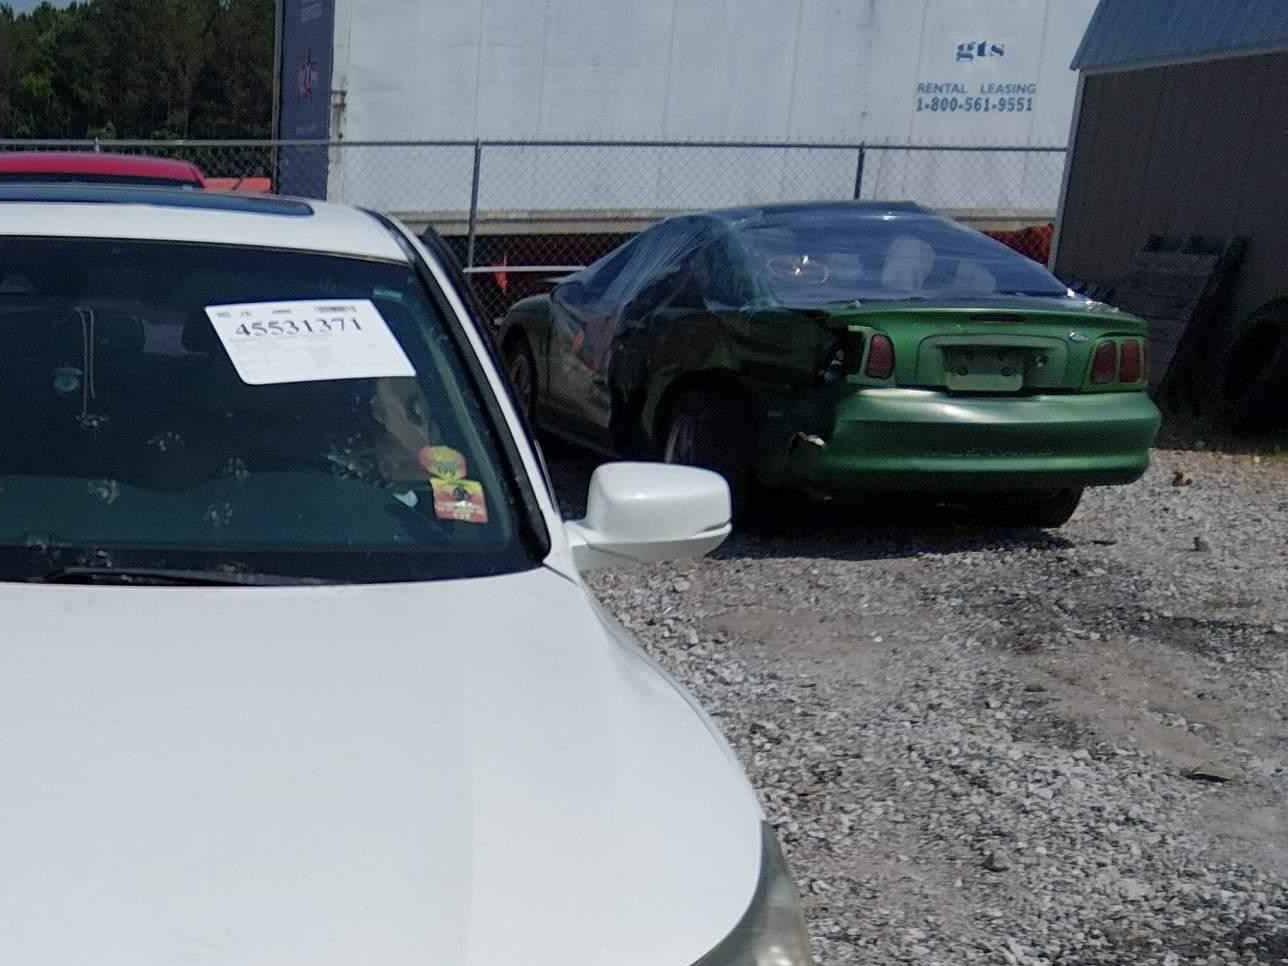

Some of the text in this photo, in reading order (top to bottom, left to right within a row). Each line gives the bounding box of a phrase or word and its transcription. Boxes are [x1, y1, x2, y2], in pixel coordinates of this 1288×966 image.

[956, 40, 1005, 61] gts
[917, 83, 1037, 94] RENTAL LEASING
[916, 97, 1032, 112] 1-800-561-9551
[235, 318, 362, 336] 45531371
